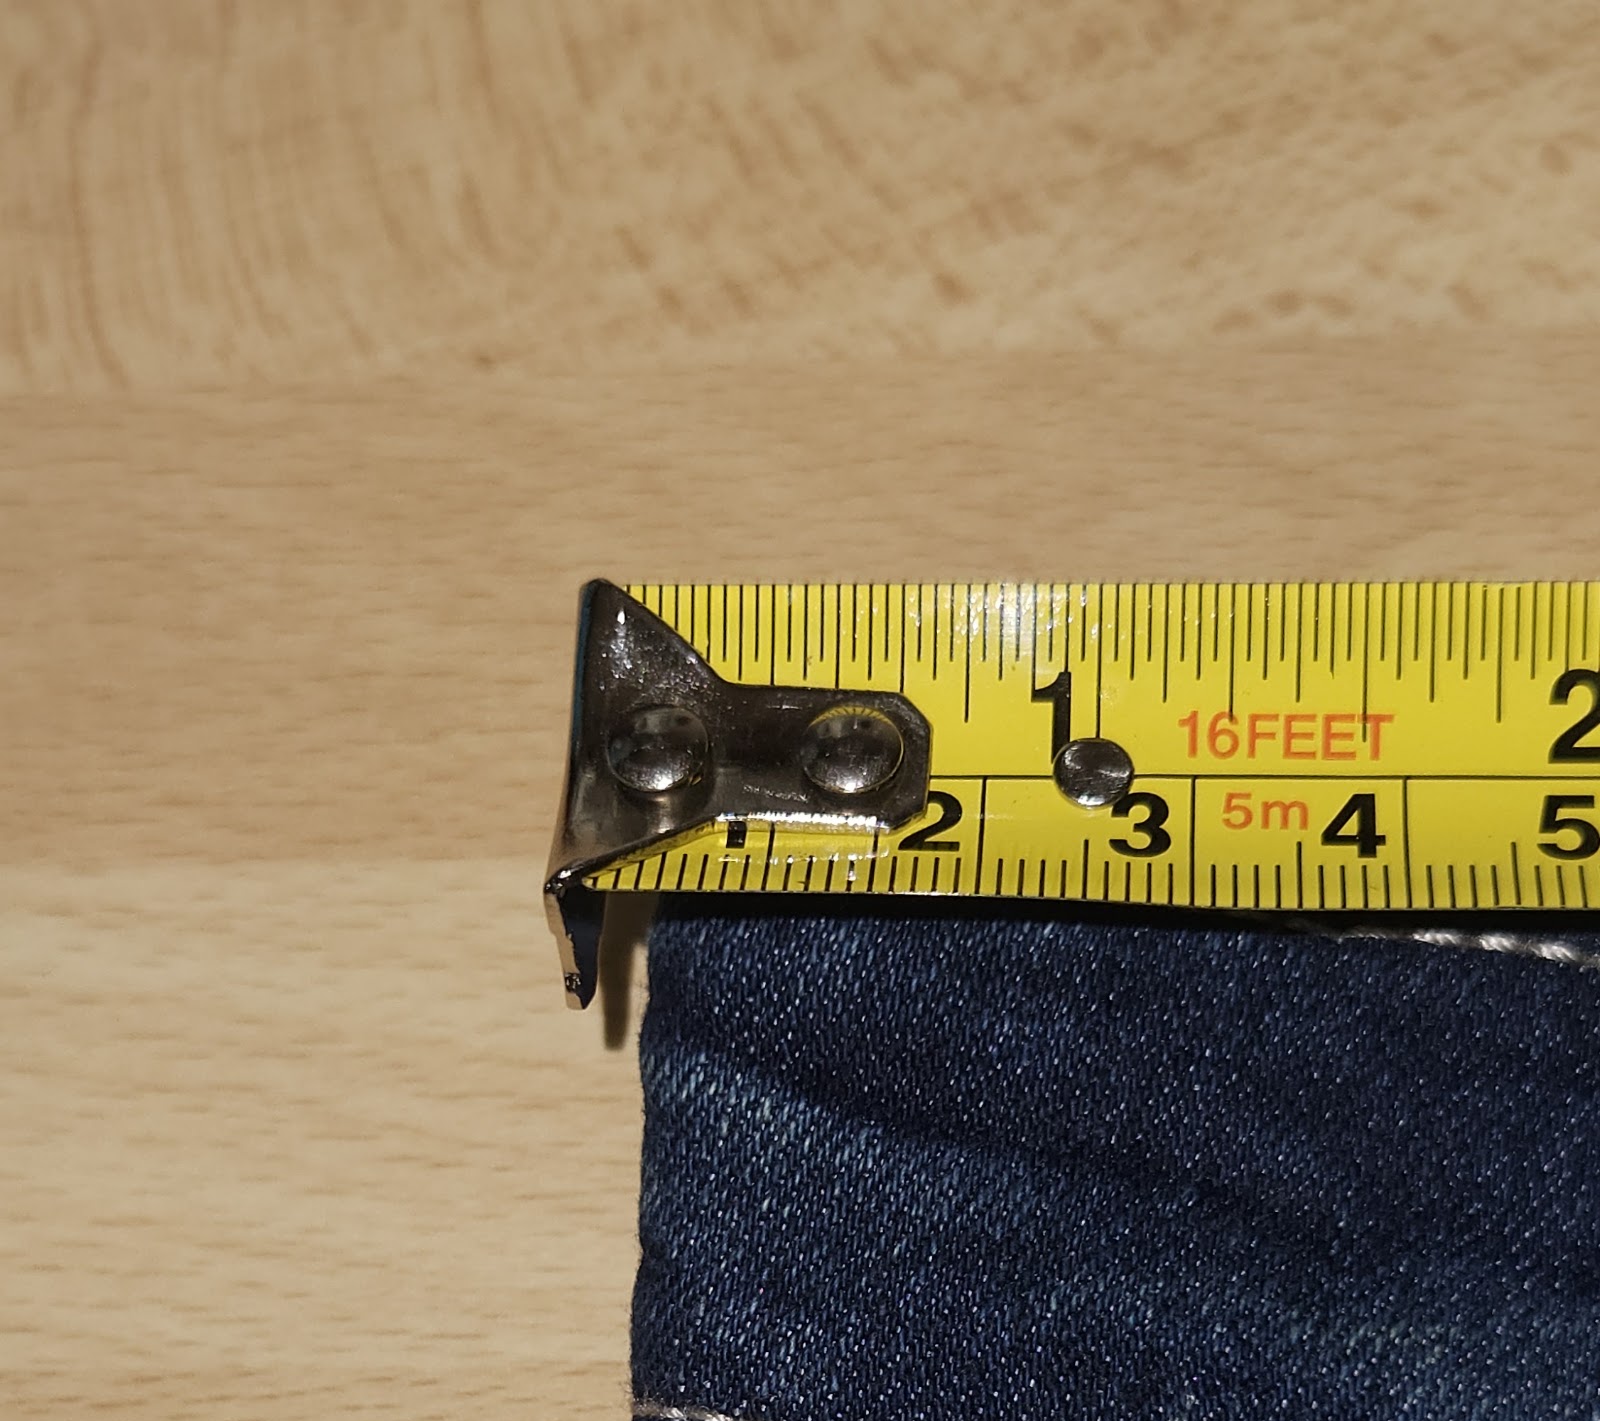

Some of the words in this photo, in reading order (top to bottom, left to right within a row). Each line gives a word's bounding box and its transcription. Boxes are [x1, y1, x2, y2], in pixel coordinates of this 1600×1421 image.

[1031, 671, 1071, 763] 1
[1178, 710, 1395, 761] 16FEET
[1548, 669, 1600, 764] 2
[897, 791, 963, 852] 2
[1108, 792, 1171, 857] 3
[1221, 793, 1310, 830] 5m
[1321, 793, 1386, 858] 4
[1536, 795, 1600, 860] 5
